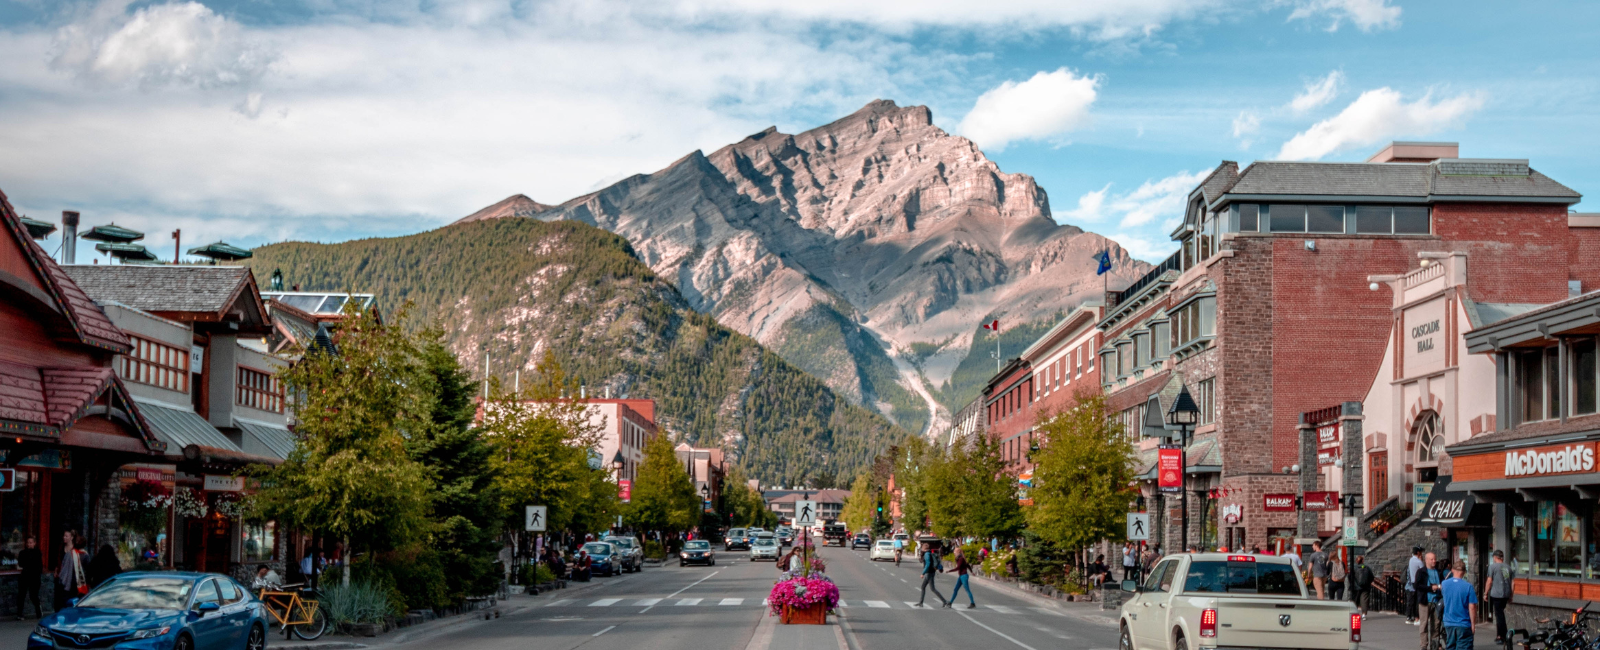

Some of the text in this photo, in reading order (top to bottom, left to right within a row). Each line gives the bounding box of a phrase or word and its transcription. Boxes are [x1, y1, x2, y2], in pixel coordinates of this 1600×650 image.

[1412, 319, 1440, 339] CASCADE
[1417, 337, 1434, 353] HALL
[1505, 445, 1594, 476] McDonald's
[138, 471, 161, 481] ORIGINAL
[1428, 499, 1466, 518] CHAYA
